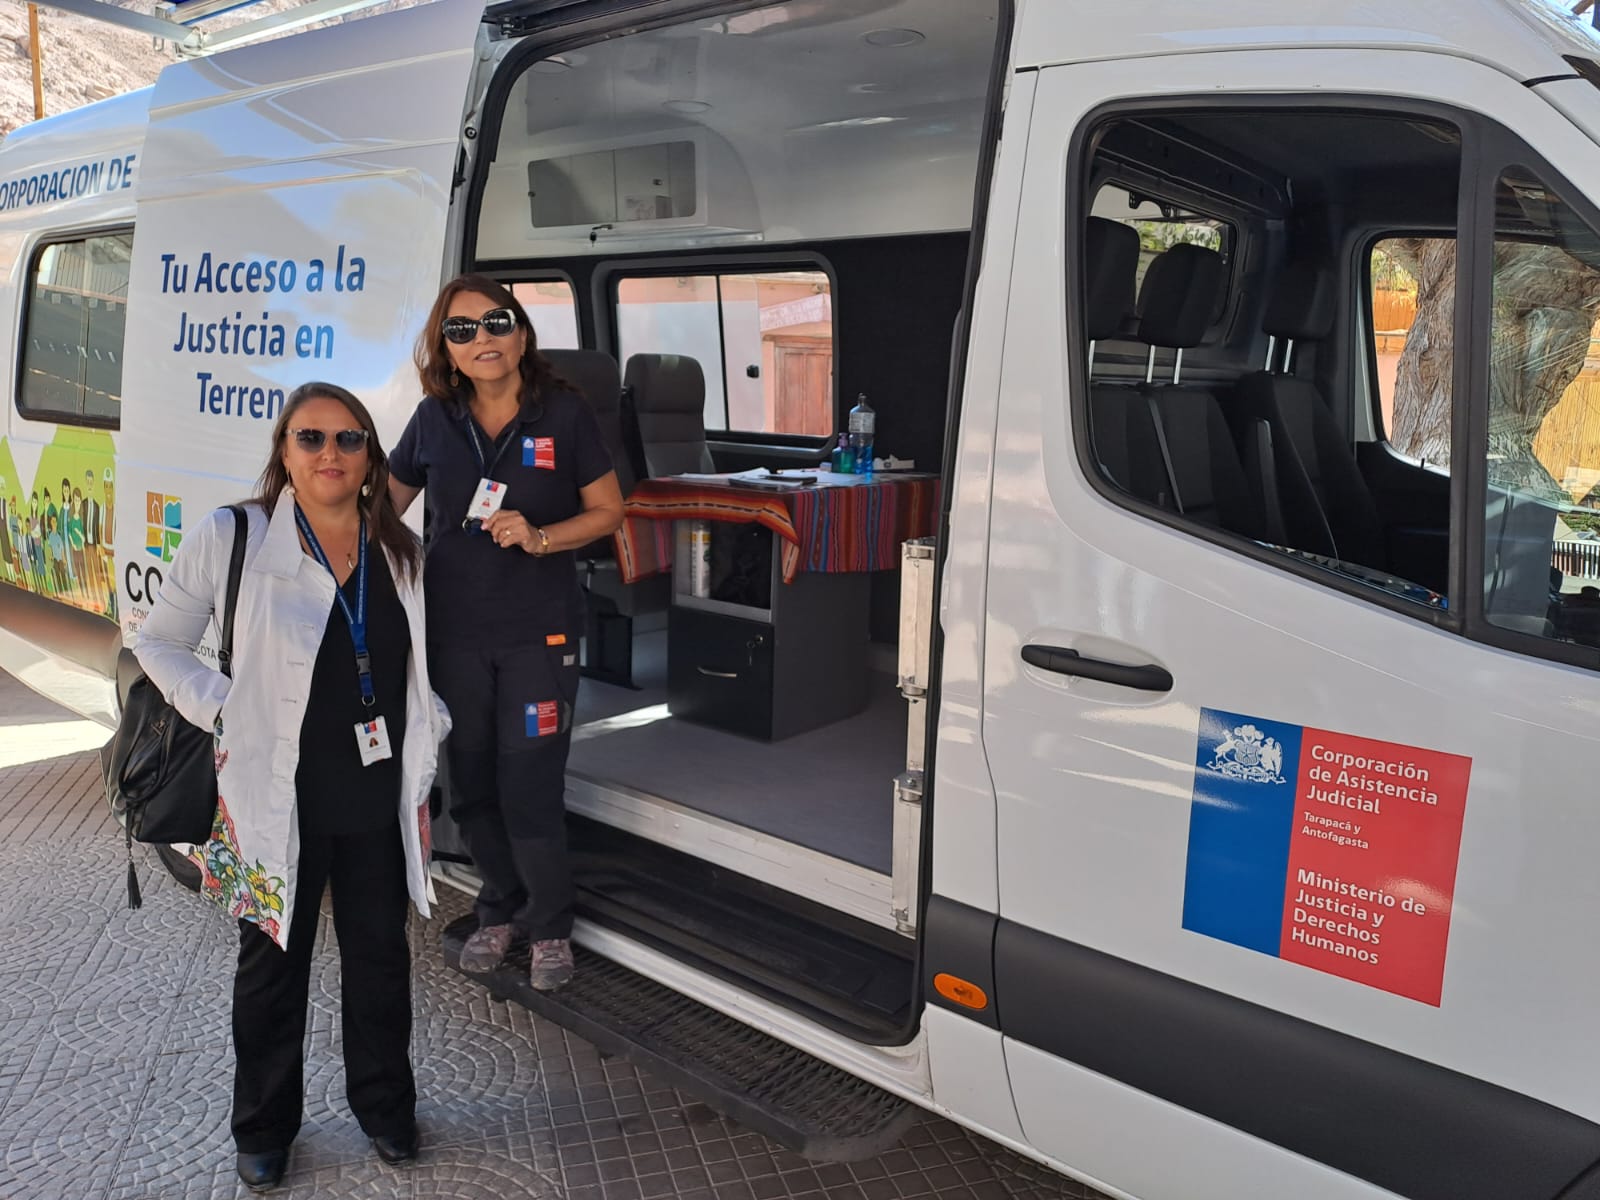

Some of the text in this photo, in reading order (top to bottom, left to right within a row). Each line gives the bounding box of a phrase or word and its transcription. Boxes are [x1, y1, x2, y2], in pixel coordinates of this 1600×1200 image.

[0, 154, 137, 211] ORPORACION DE
[161, 244, 366, 294] Tu Acceso a la
[173, 311, 335, 359] Justicia en
[197, 372, 285, 420] Terren
[125, 561, 164, 606] CO
[1310, 744, 1430, 783] Corporación
[1306, 785, 1381, 815] Judicial
[1308, 765, 1439, 806] de Asistencia
[1301, 825, 1370, 850] Antofagasta
[1303, 811, 1362, 835] Tarapacá y
[1295, 888, 1385, 929] Justicia y
[1296, 868, 1426, 916] Ministerio de
[1291, 926, 1380, 965] Humanos
[1293, 907, 1381, 945] Derechos
